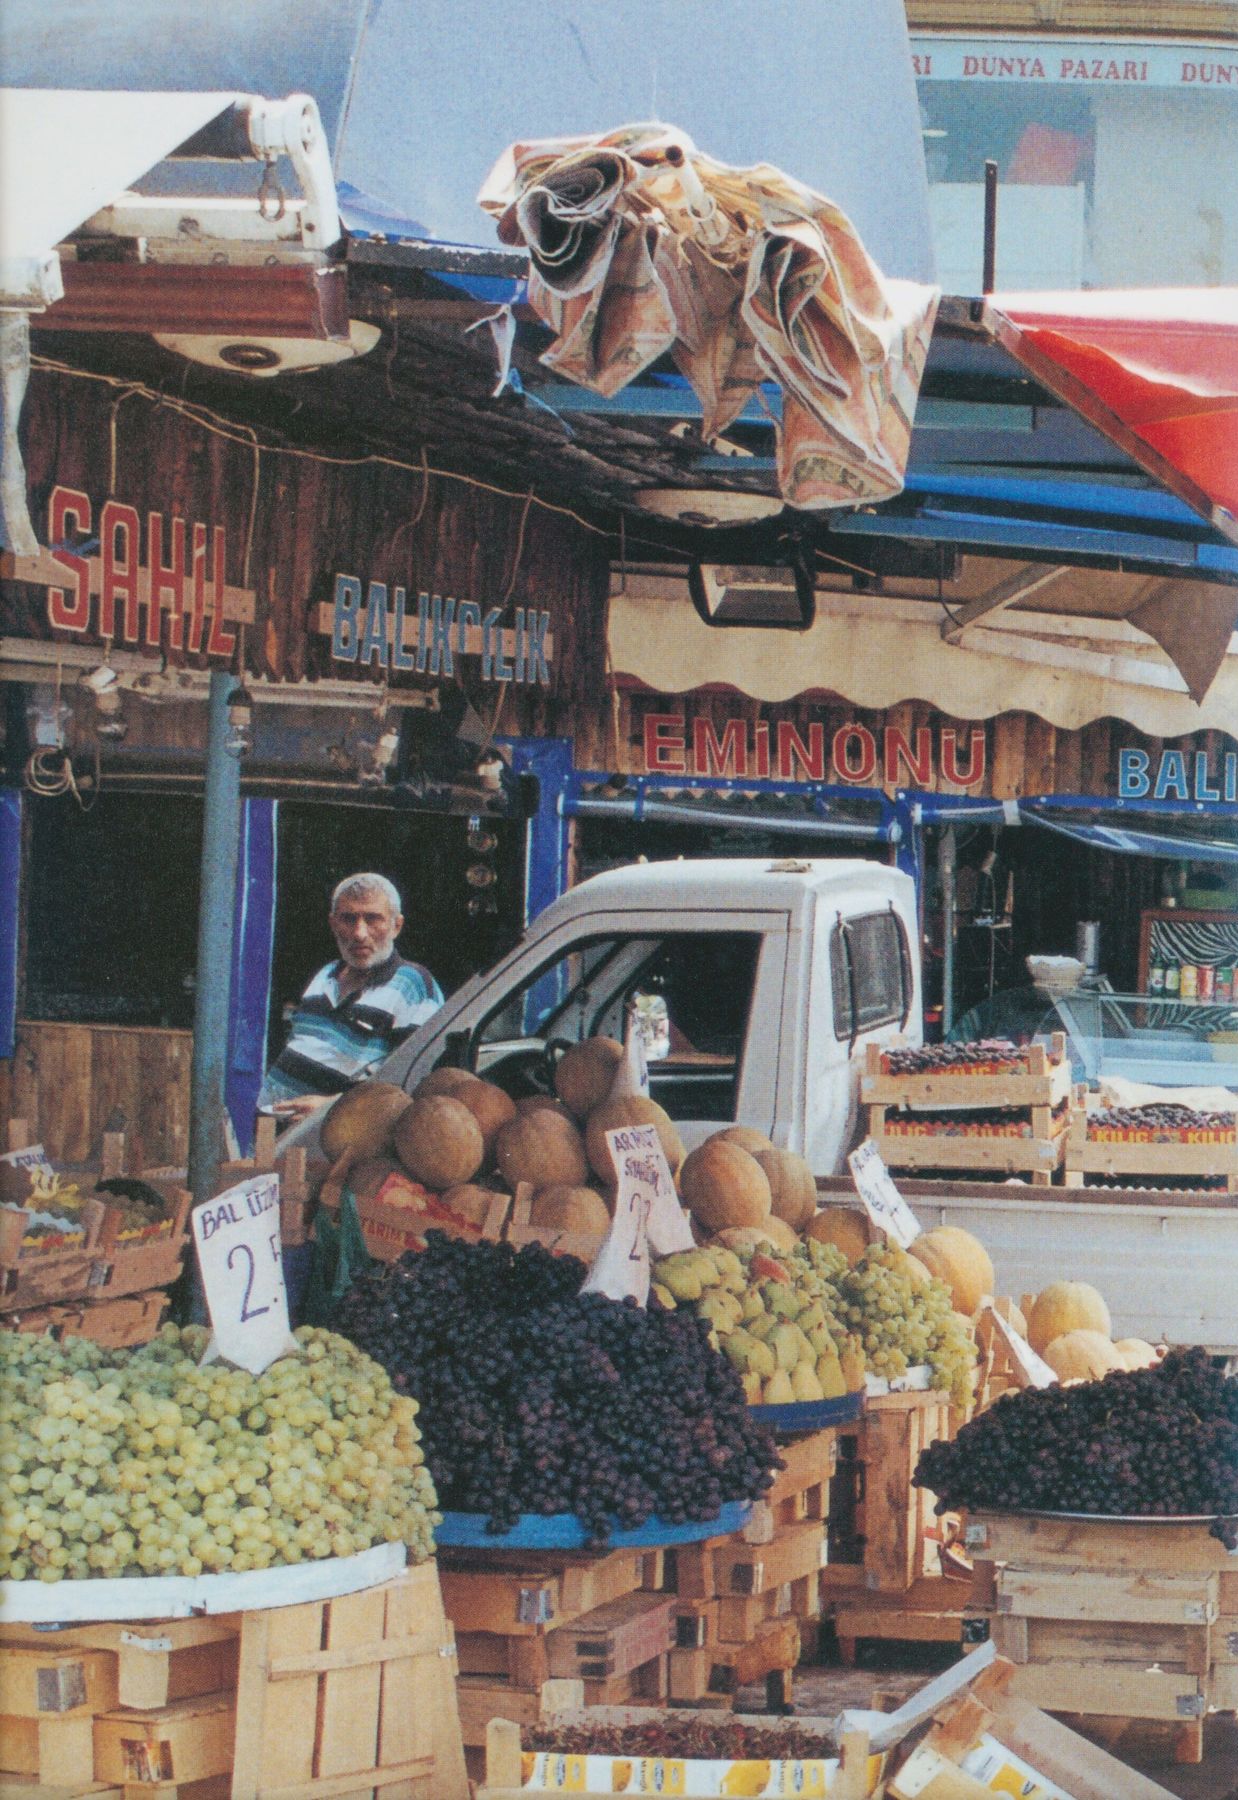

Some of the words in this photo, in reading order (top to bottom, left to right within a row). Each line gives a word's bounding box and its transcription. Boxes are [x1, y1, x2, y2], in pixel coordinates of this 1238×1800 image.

[1060, 58, 1148, 81] PAZARI
[201, 1203, 243, 1240] BAL
[227, 1244, 270, 1323] 2
